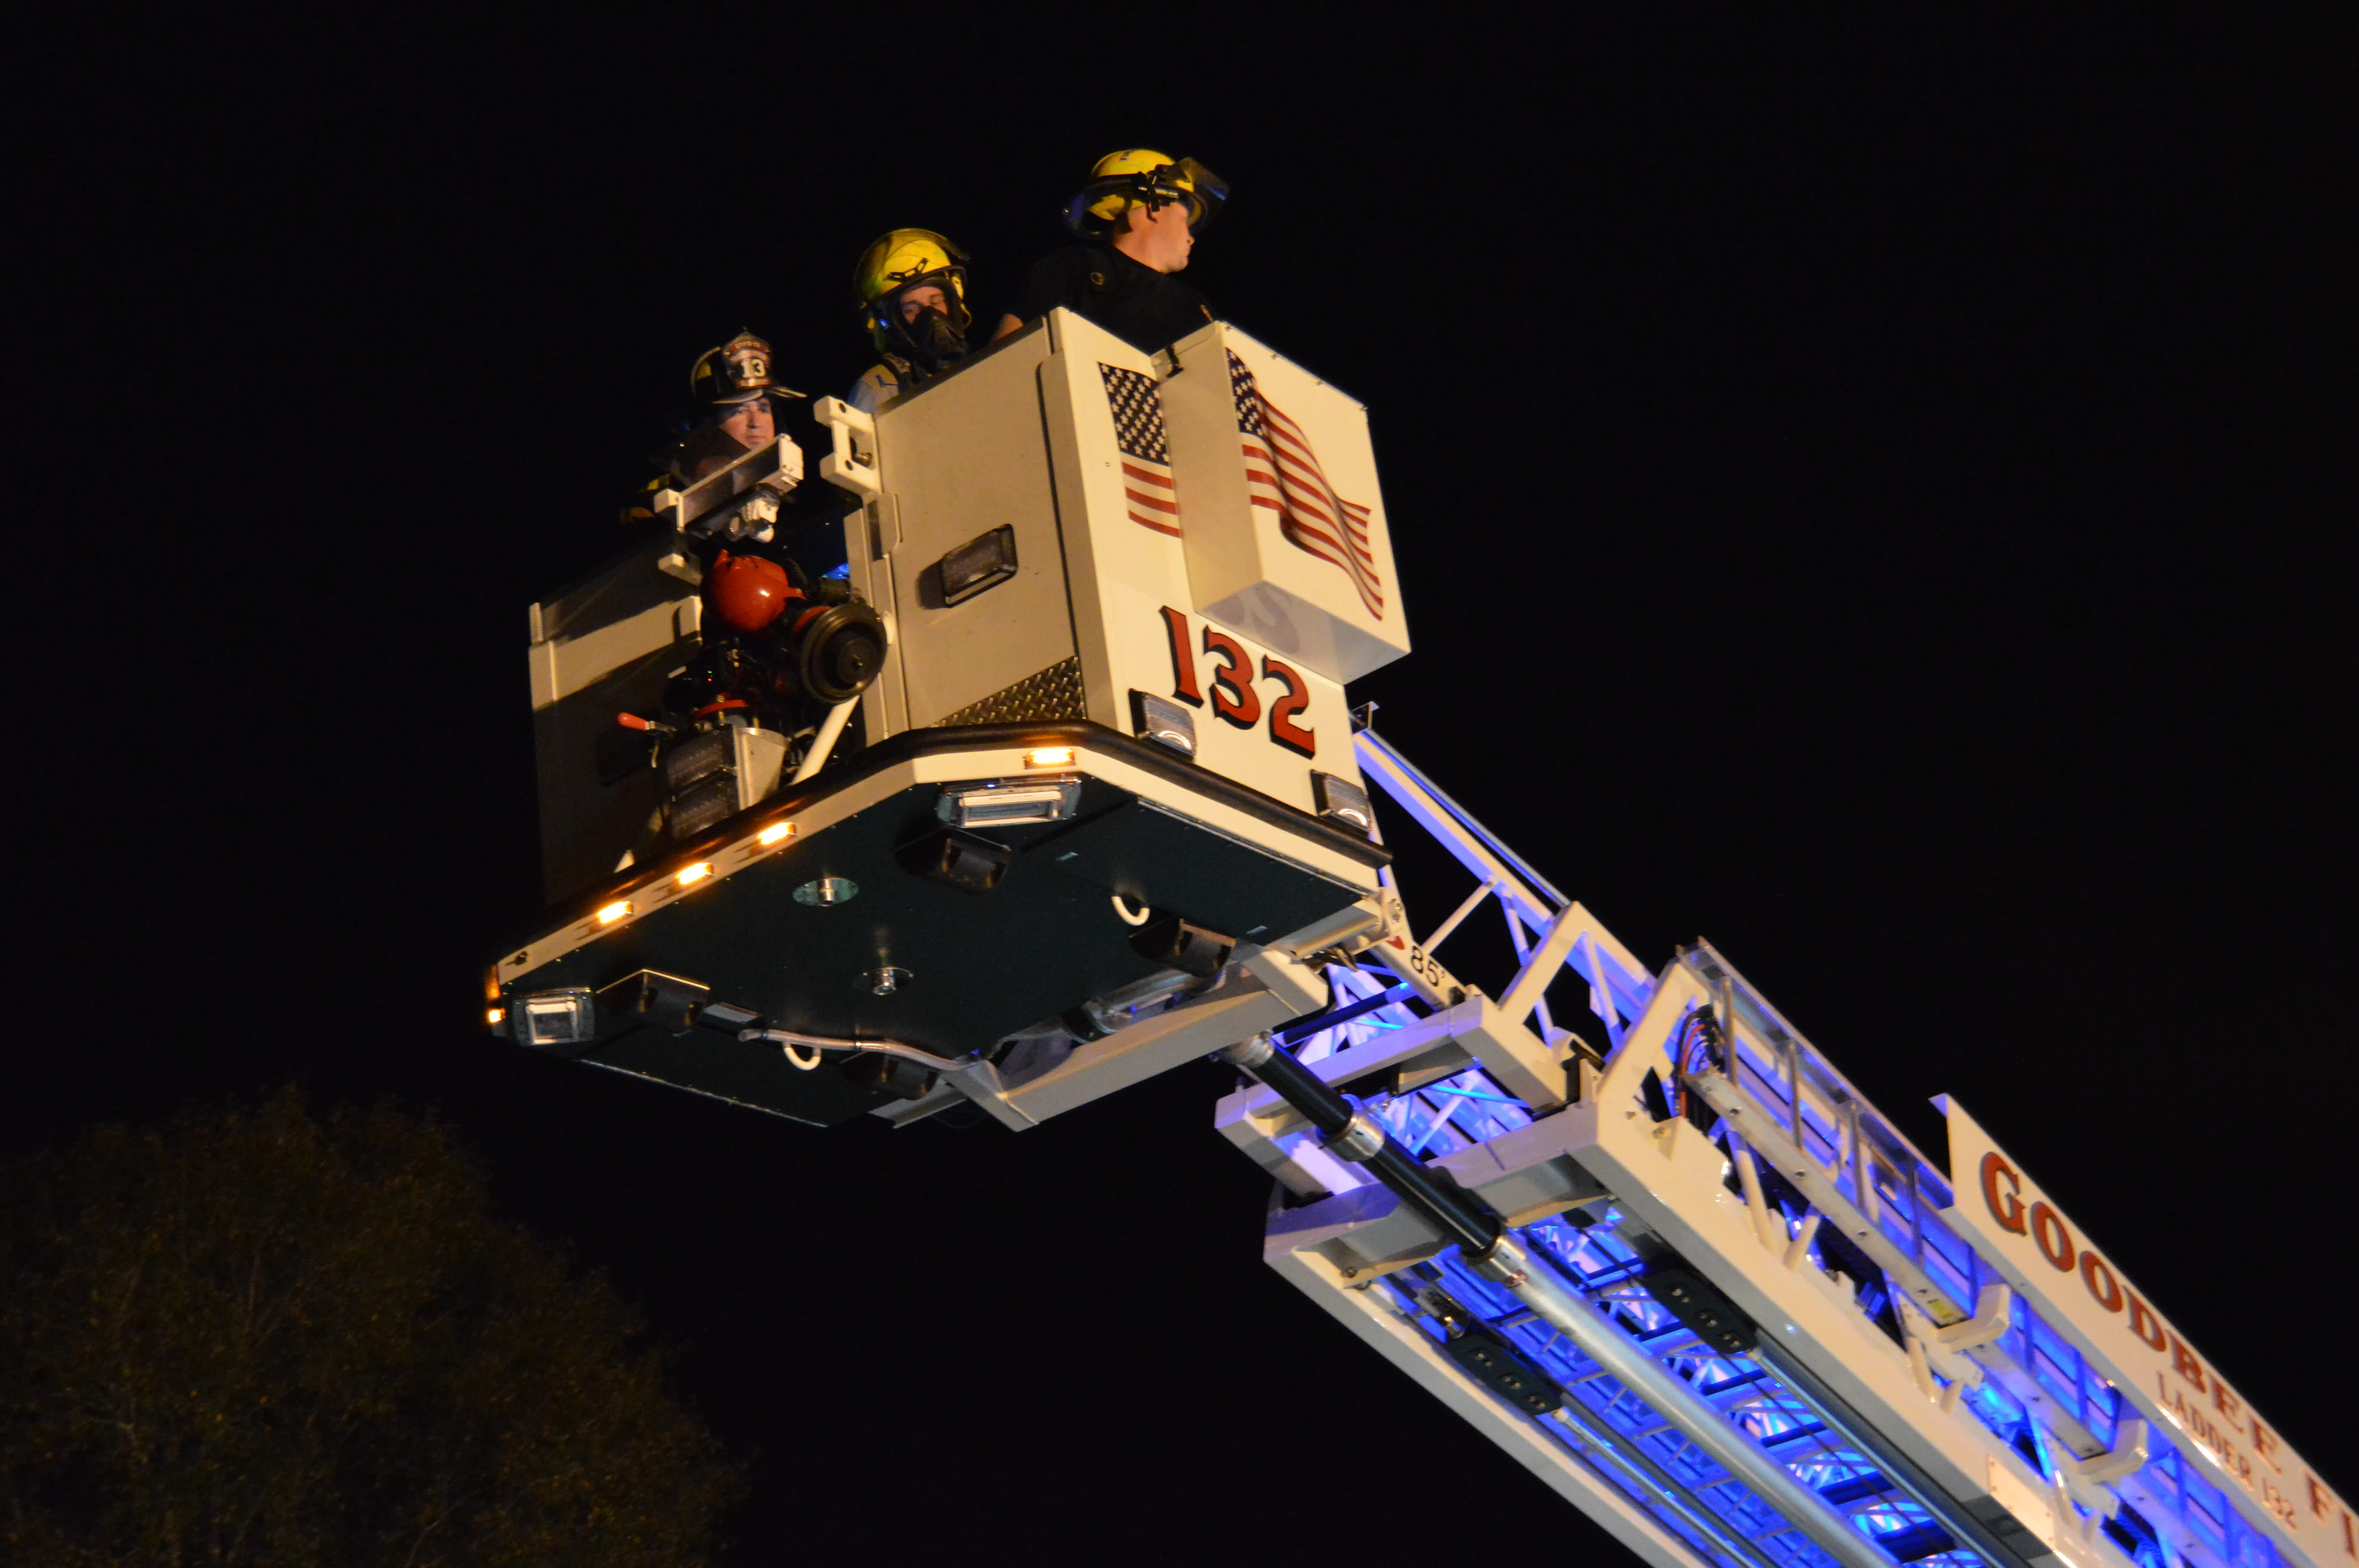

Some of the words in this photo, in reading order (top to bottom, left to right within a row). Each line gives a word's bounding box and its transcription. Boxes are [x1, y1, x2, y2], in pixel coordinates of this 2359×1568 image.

[741, 358, 765, 377] 13
[1159, 605, 1316, 760] 132
[1979, 1151, 2283, 1475] GOODBEE
[2157, 1372, 2254, 1490] LADDER
[2261, 1477, 2297, 1532] 132
